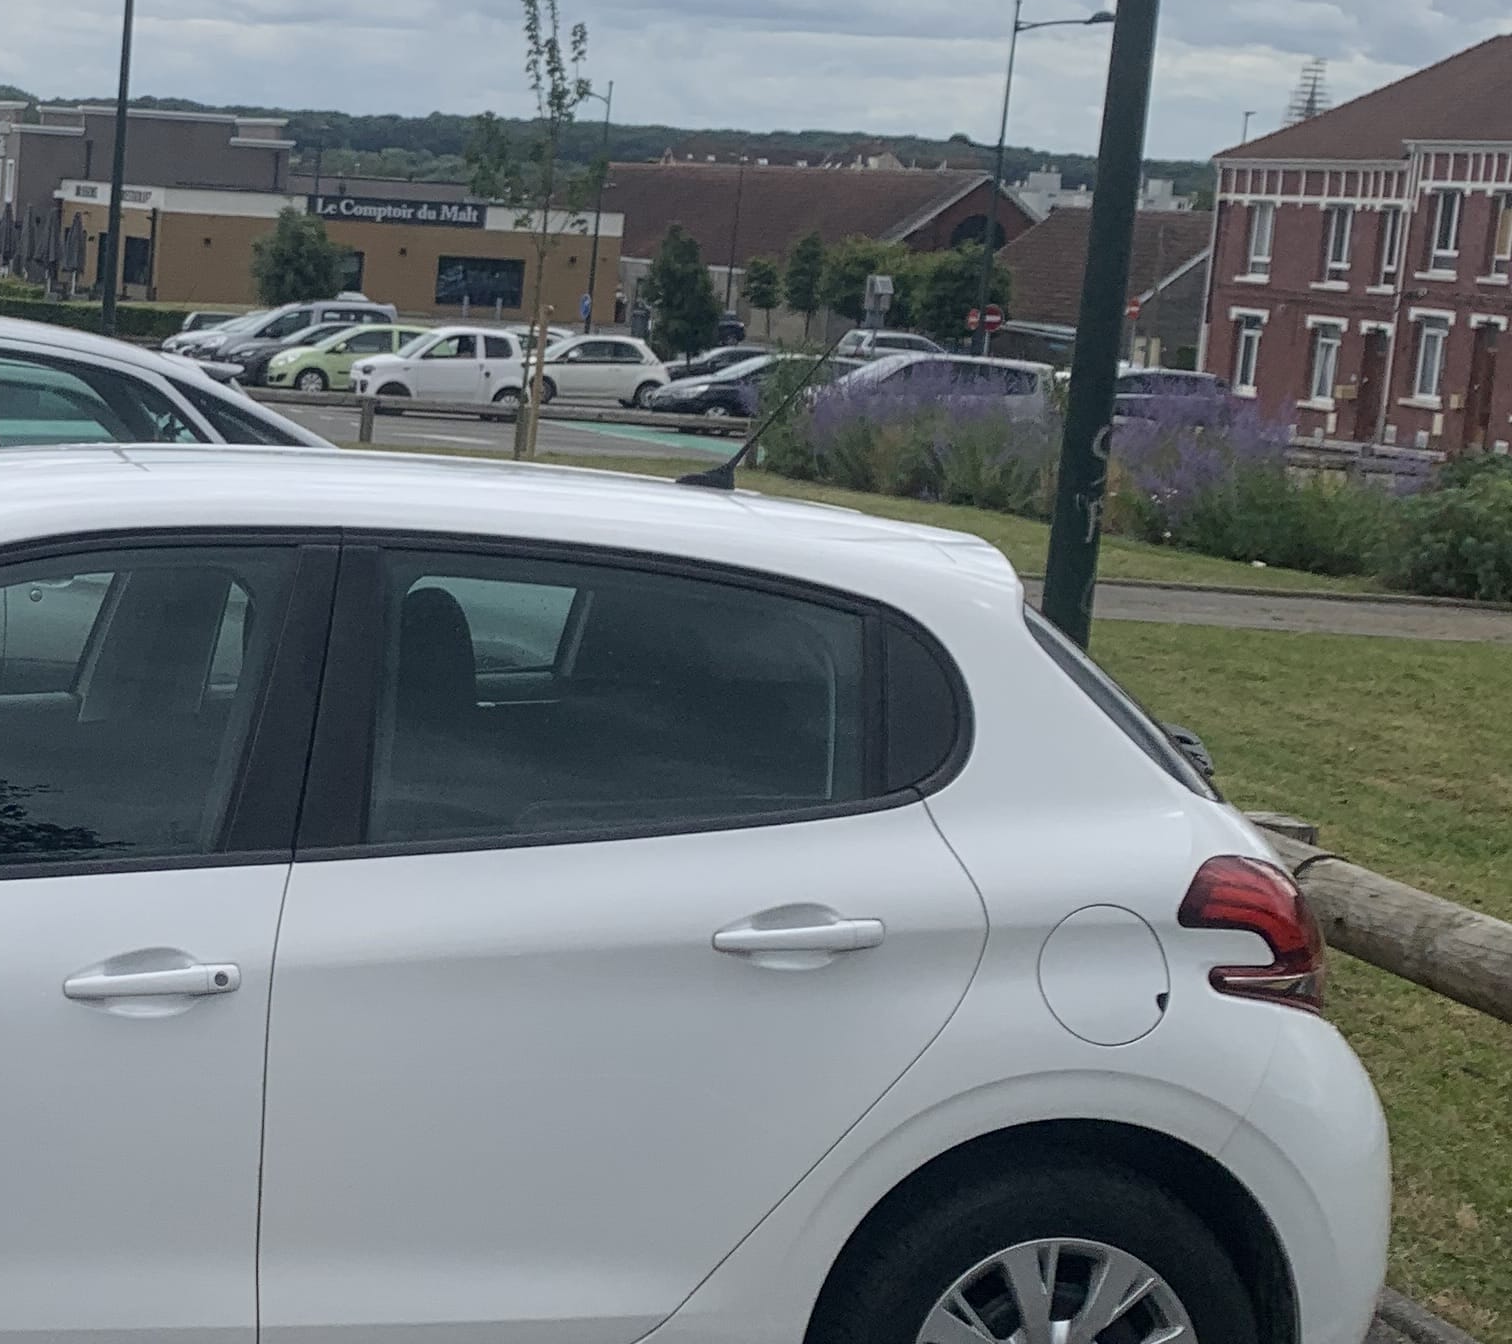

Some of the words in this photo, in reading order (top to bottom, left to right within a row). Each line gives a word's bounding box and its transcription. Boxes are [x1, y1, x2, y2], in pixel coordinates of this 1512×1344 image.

[316, 198, 337, 215] Le
[340, 199, 415, 222] Comptoir
[417, 204, 437, 220] du
[439, 205, 479, 223] Malt
